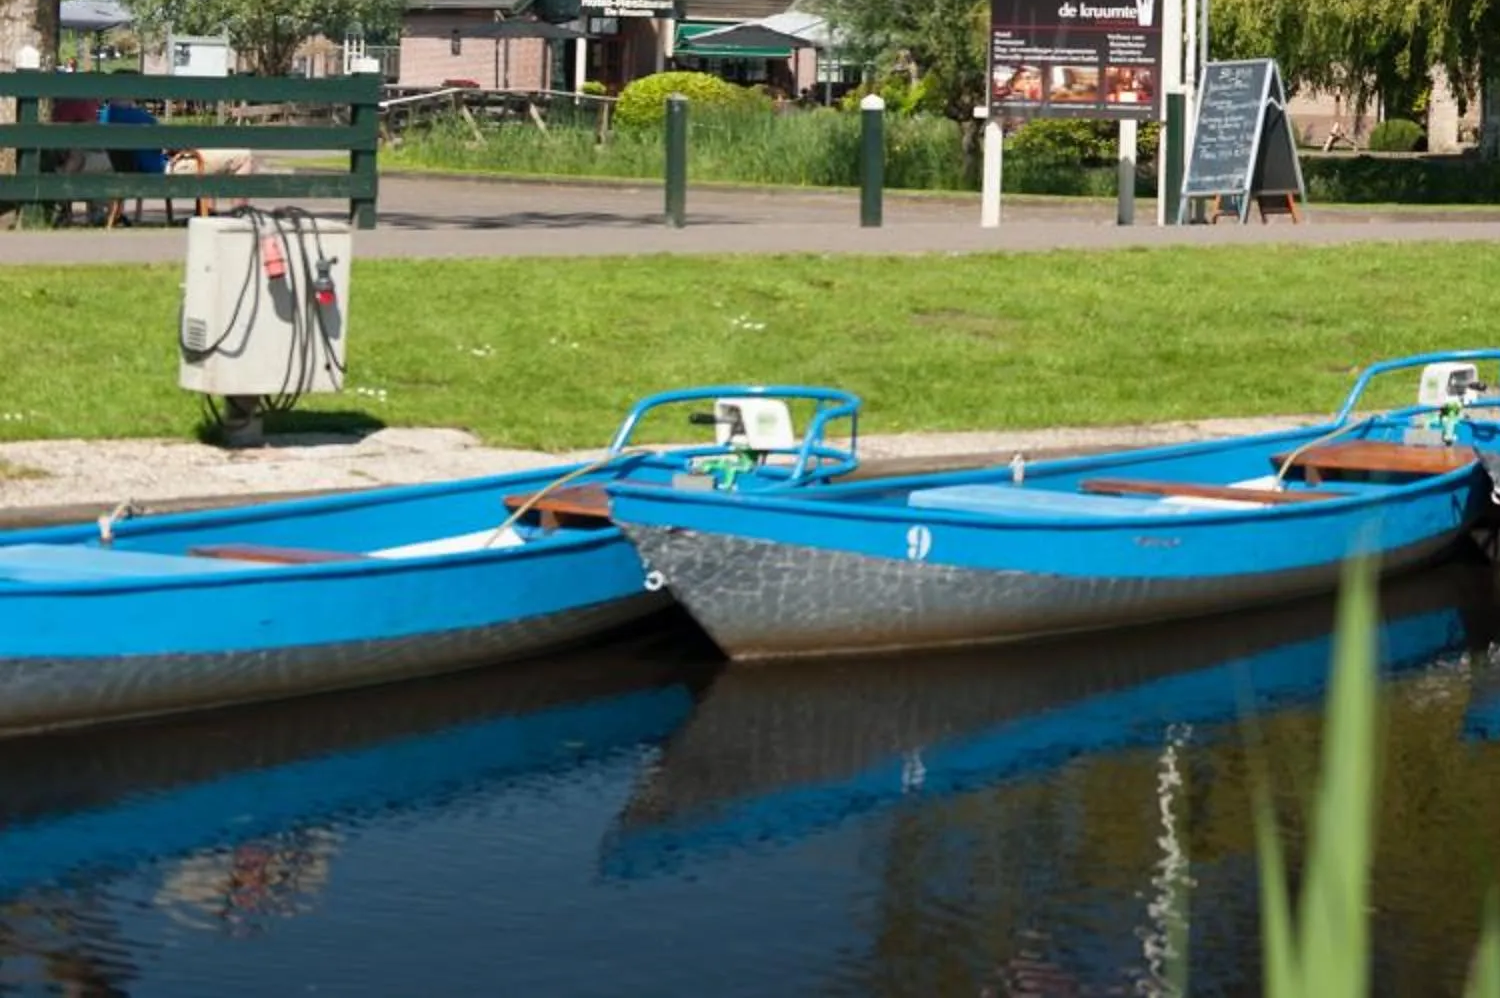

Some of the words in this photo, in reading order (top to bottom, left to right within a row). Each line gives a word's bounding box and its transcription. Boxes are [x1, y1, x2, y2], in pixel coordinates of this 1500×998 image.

[1058, 2, 1077, 17] de
[1080, 2, 1137, 19] kruumte
[906, 524, 931, 560] 9
